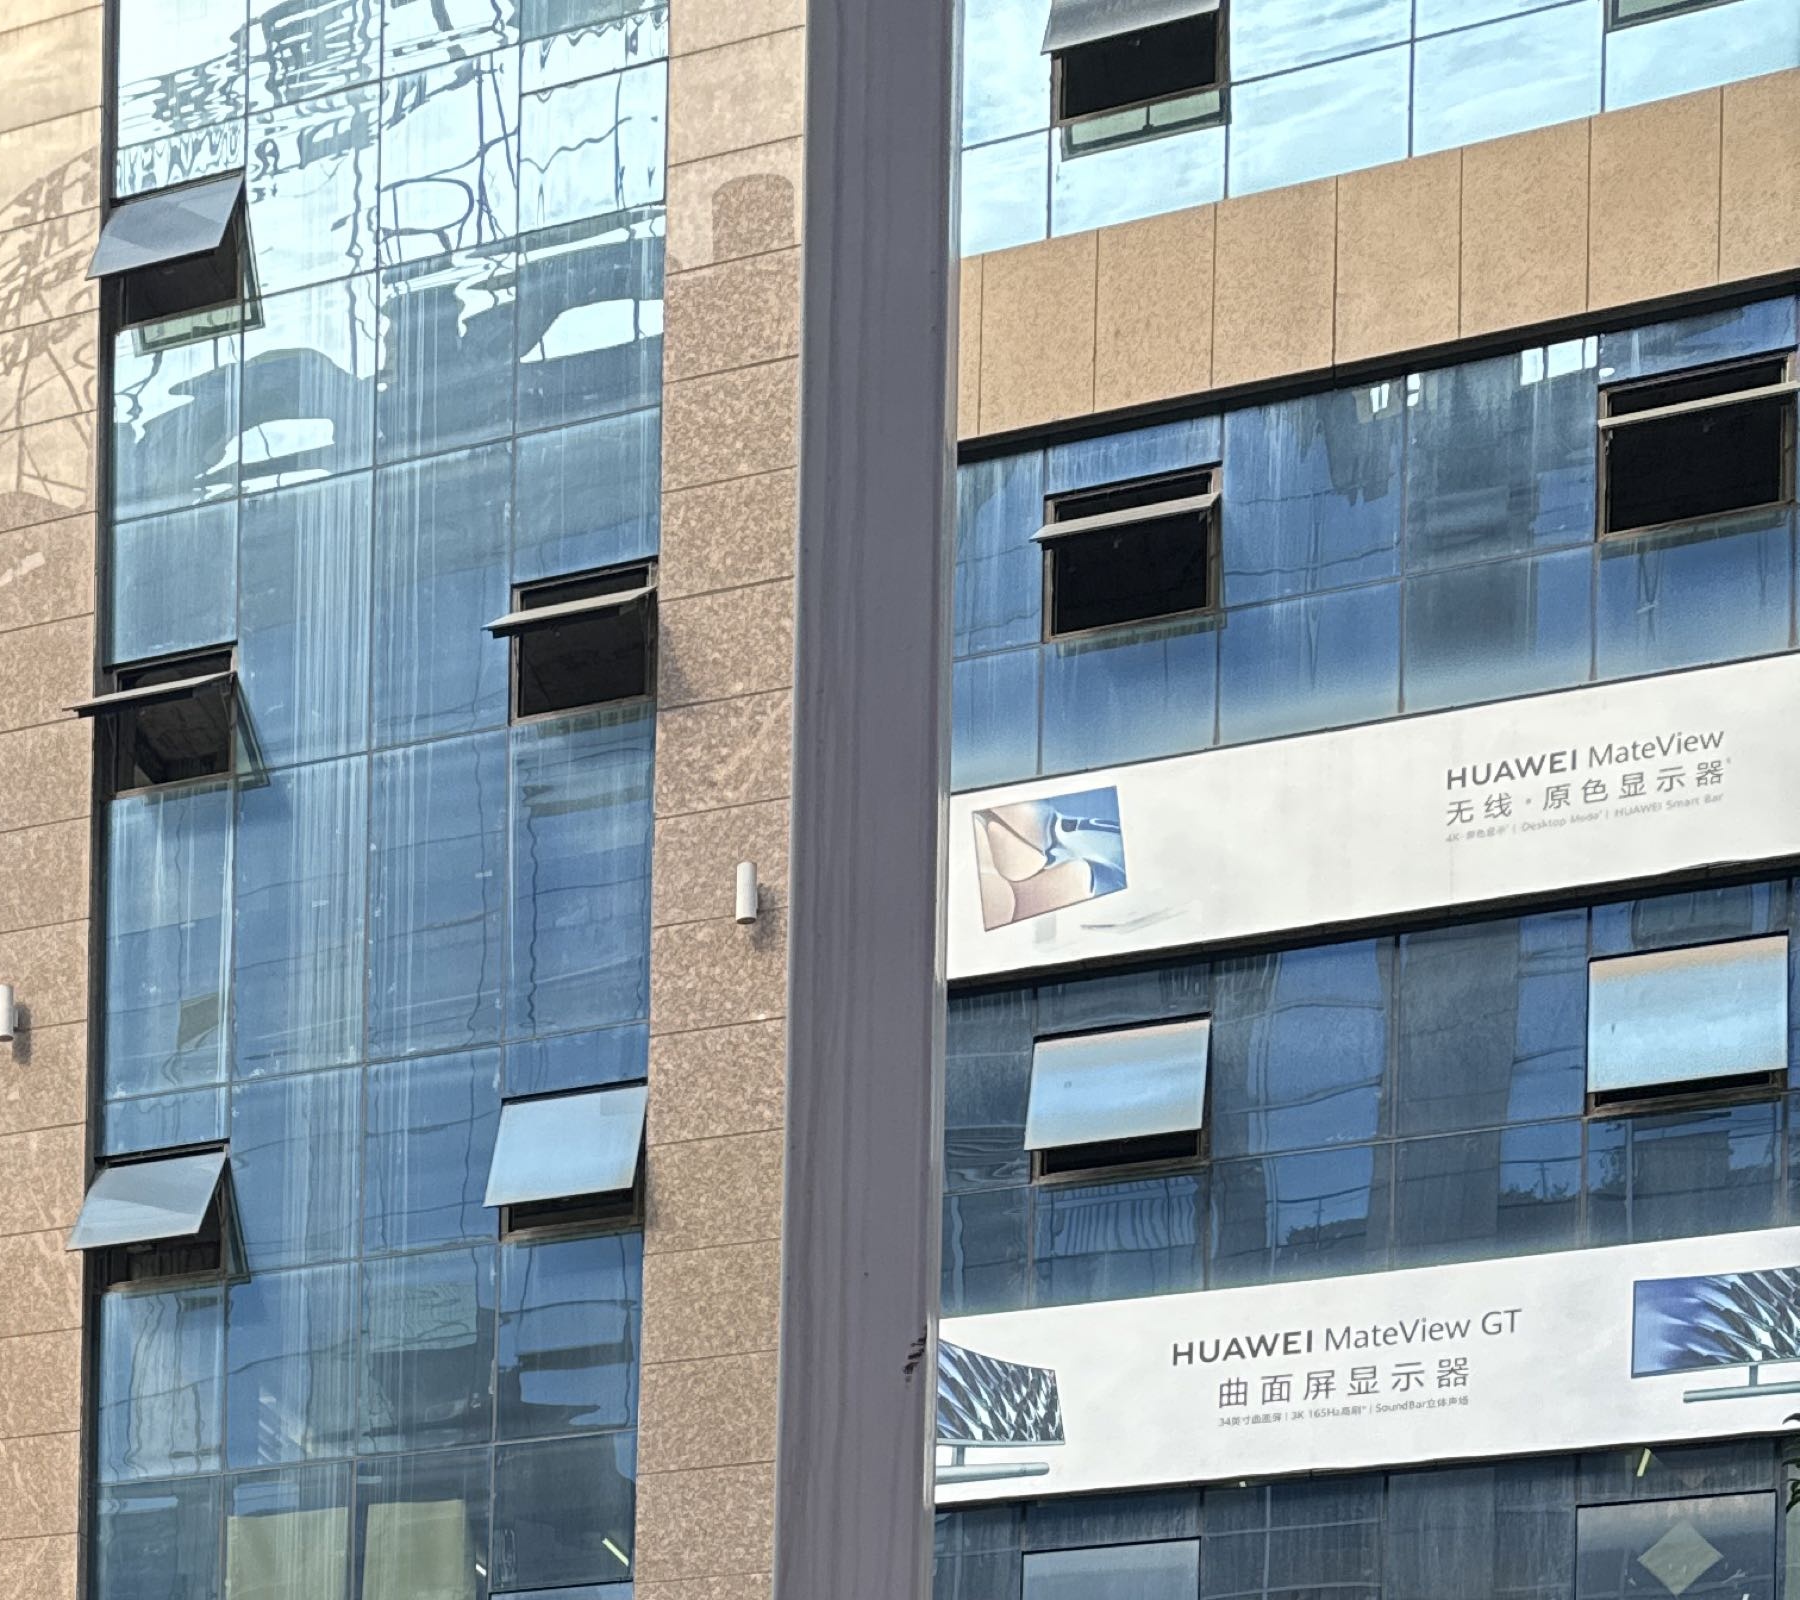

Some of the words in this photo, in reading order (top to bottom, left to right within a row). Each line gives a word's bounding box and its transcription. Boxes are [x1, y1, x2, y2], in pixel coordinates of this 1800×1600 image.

[1446, 748, 1578, 791] HUAWEI
[1587, 730, 1725, 769] MateView
[1614, 803, 1663, 819] HUAWEI
[1171, 1329, 1314, 1367] HUAWEI
[1324, 1317, 1472, 1352] MateView
[1480, 1308, 1523, 1336] GT
[1217, 1356, 1470, 1410] 曲面屏显示器
